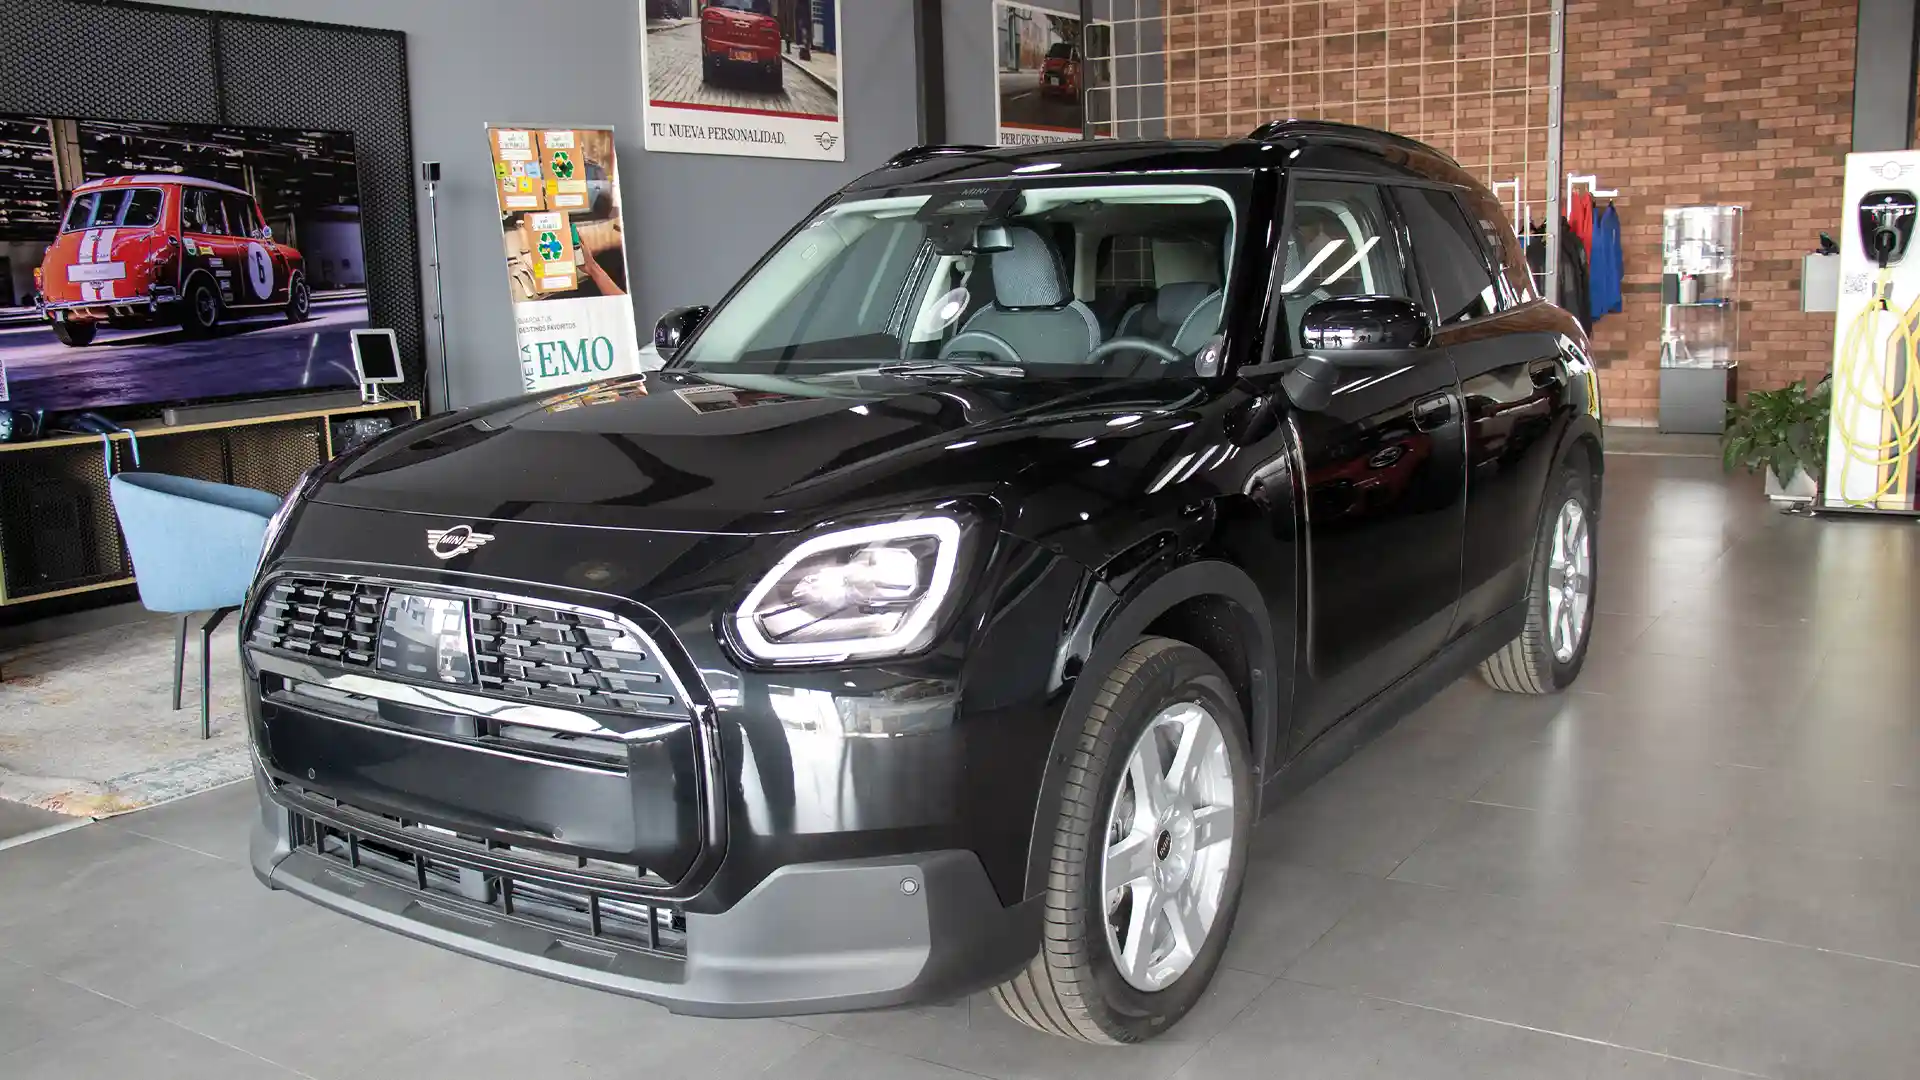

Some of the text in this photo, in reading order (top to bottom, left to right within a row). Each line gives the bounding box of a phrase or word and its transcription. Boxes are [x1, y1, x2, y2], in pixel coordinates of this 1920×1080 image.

[651, 123, 786, 144] TU NUEVA PERSONALIDAD.
[1000, 132, 1040, 145] PERDERSE
[255, 251, 266, 284] 6
[518, 322, 576, 334] DESTINOS FAVORITOS
[521, 344, 532, 362] LA
[535, 336, 614, 378] EMO
[440, 535, 466, 545] MINI
